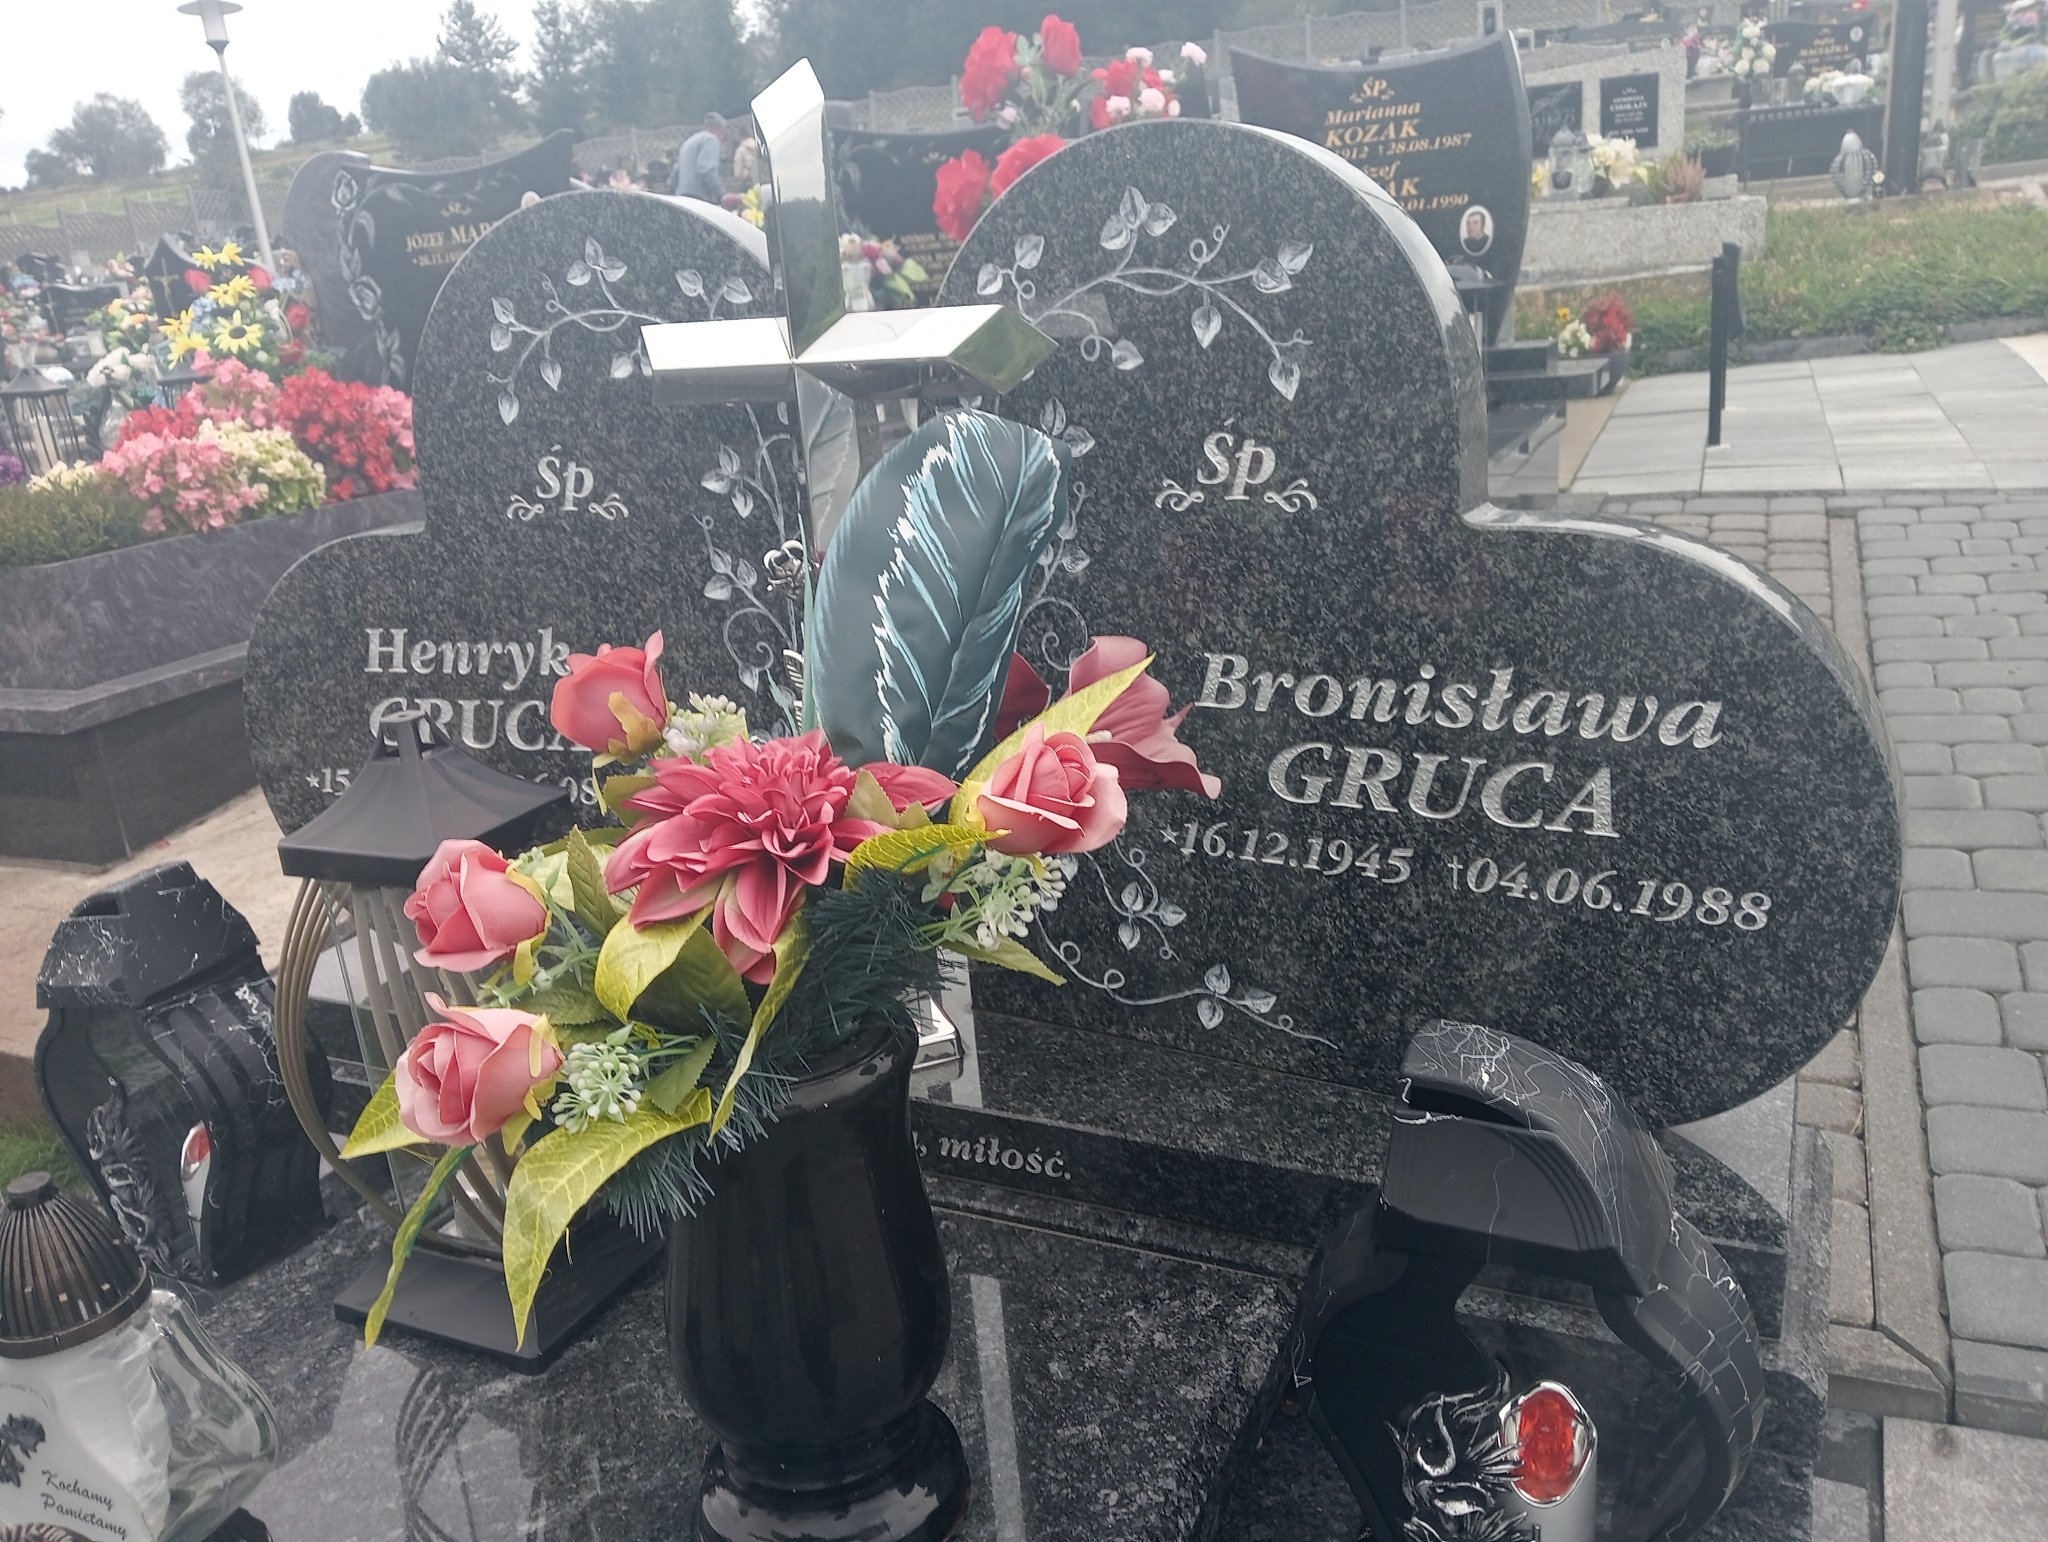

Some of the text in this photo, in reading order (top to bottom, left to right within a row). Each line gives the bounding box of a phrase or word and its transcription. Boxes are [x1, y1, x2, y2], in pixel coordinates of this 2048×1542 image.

[1325, 102, 1421, 126] Marianna
[1325, 118, 1421, 148] KOZAK
[536, 444, 594, 512] Śp
[1196, 417, 1276, 500] Śp
[364, 626, 572, 691] Henryk
[369, 697, 592, 751] GRUC
[1194, 652, 1724, 749] Bronisława
[1267, 742, 1620, 838] GRUCA
[42, 1469, 113, 1511] Kochamy
